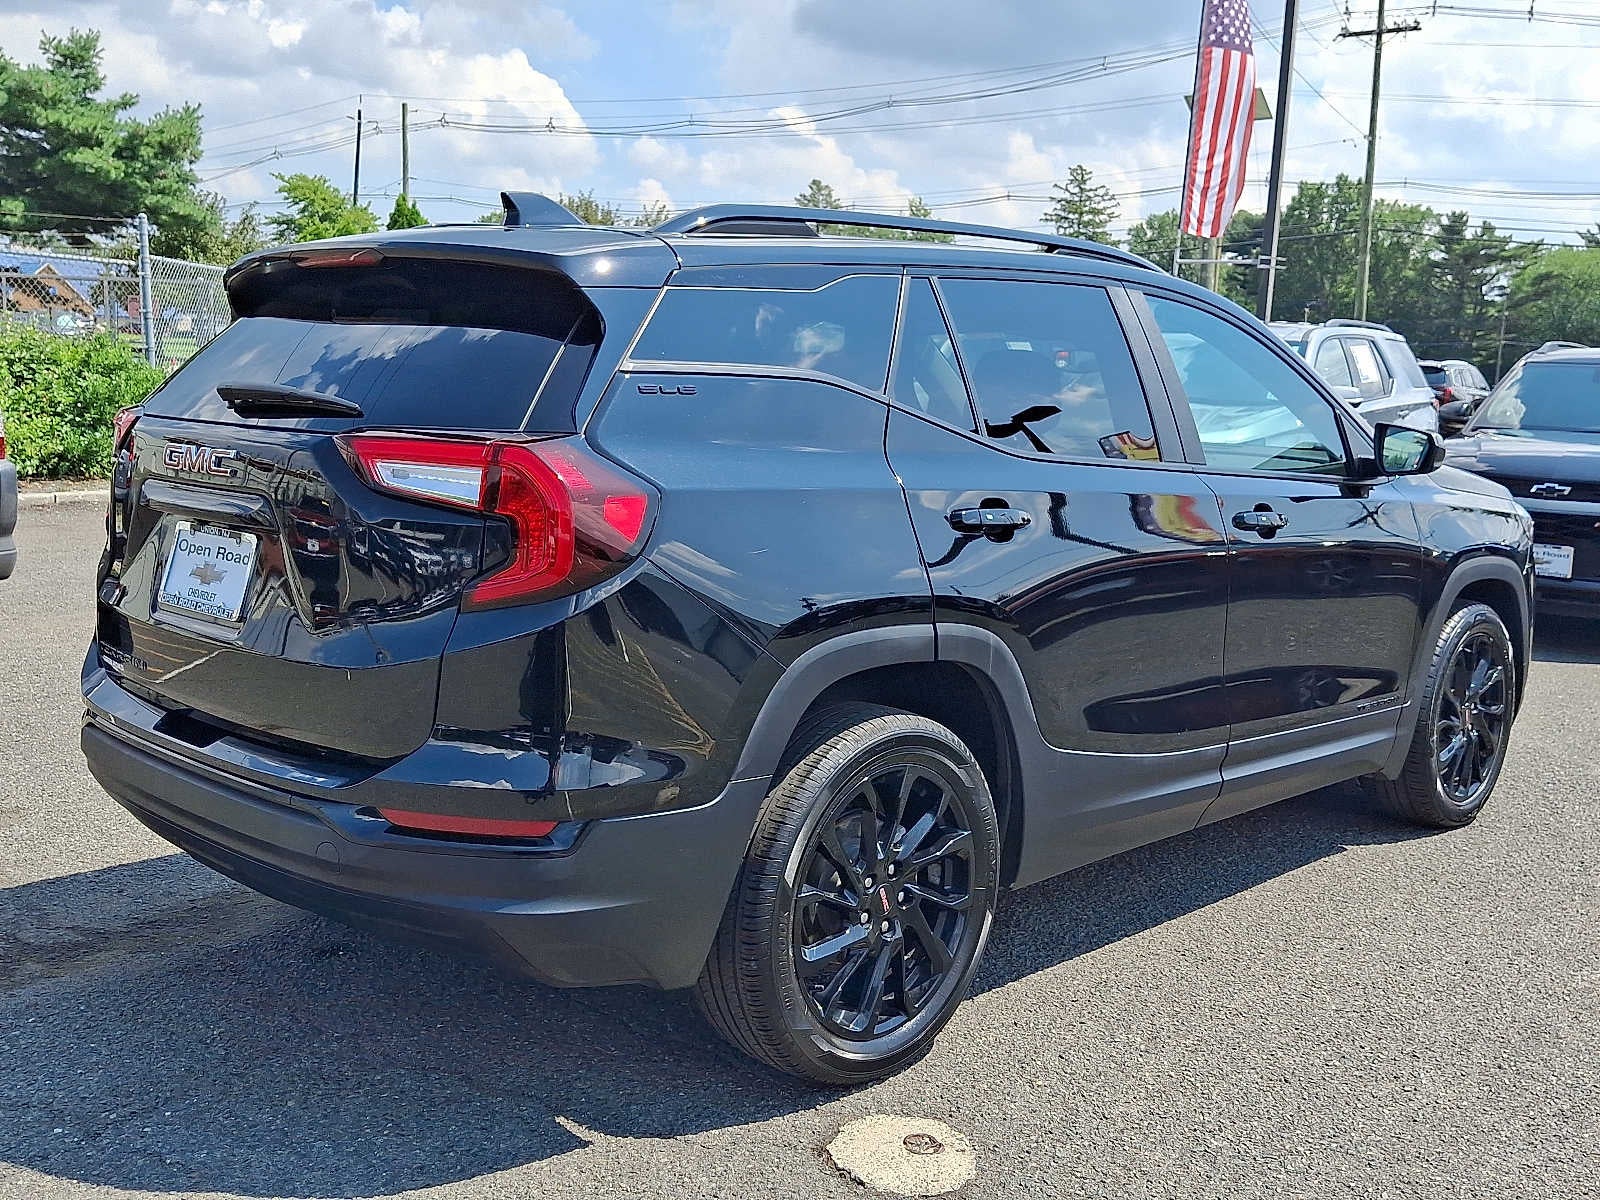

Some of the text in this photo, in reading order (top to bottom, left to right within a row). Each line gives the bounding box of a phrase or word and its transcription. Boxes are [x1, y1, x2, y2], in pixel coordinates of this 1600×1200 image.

[637, 384, 697, 396] SLE
[163, 443, 239, 477] GMC
[178, 538, 251, 566] Open Road
[162, 592, 234, 619] OPEN ROAD CHEVROLET
[187, 587, 217, 602] CHEVROLET
